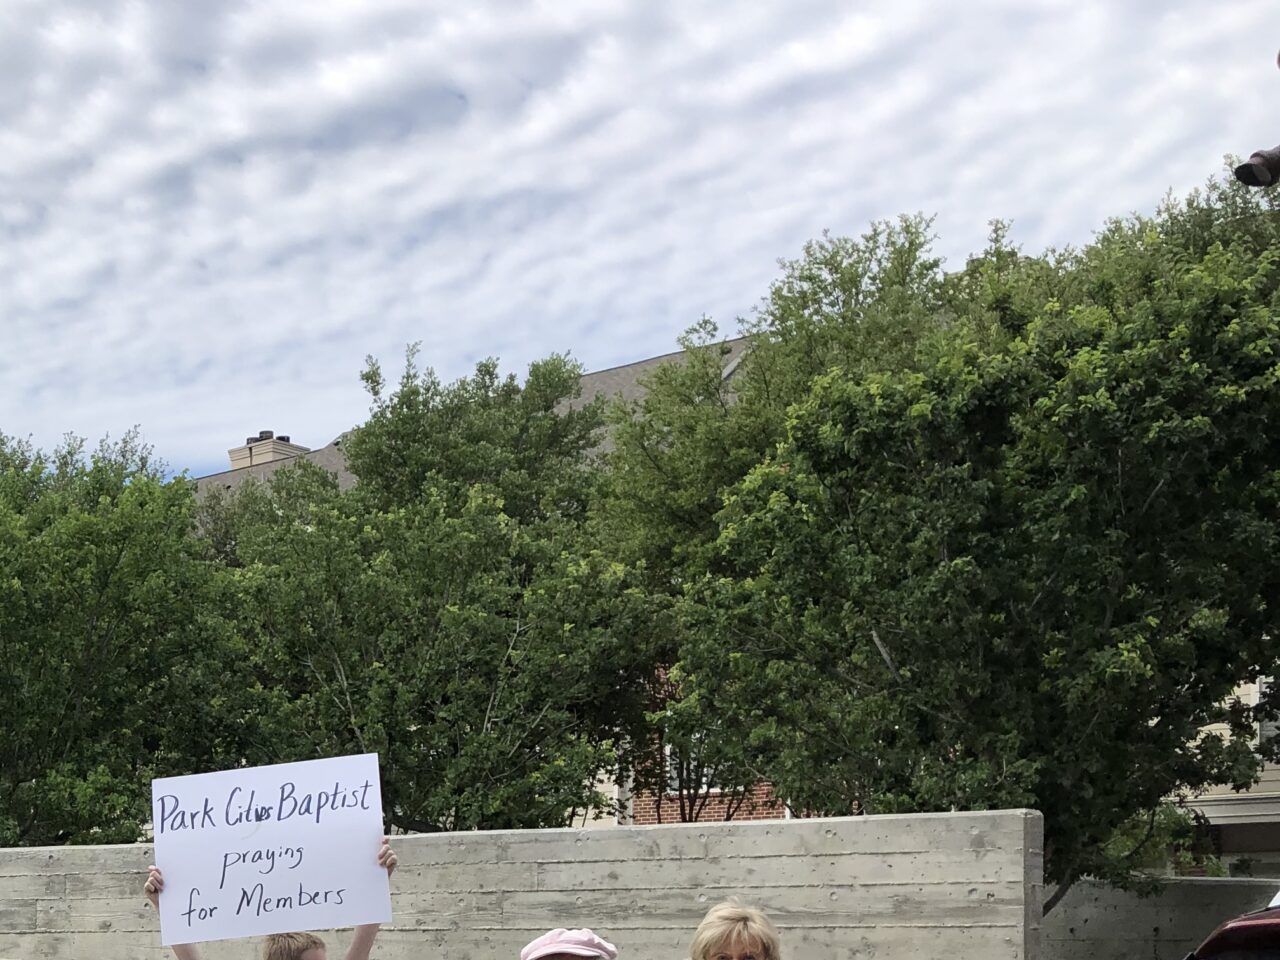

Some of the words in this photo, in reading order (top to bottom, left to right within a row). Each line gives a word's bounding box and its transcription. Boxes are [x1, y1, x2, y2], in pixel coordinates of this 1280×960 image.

[157, 794, 216, 834] Park
[225, 786, 274, 826] Cities
[277, 779, 373, 824] Baptist
[219, 845, 304, 890] praying
[180, 887, 218, 928] for
[236, 882, 347, 917] Members
